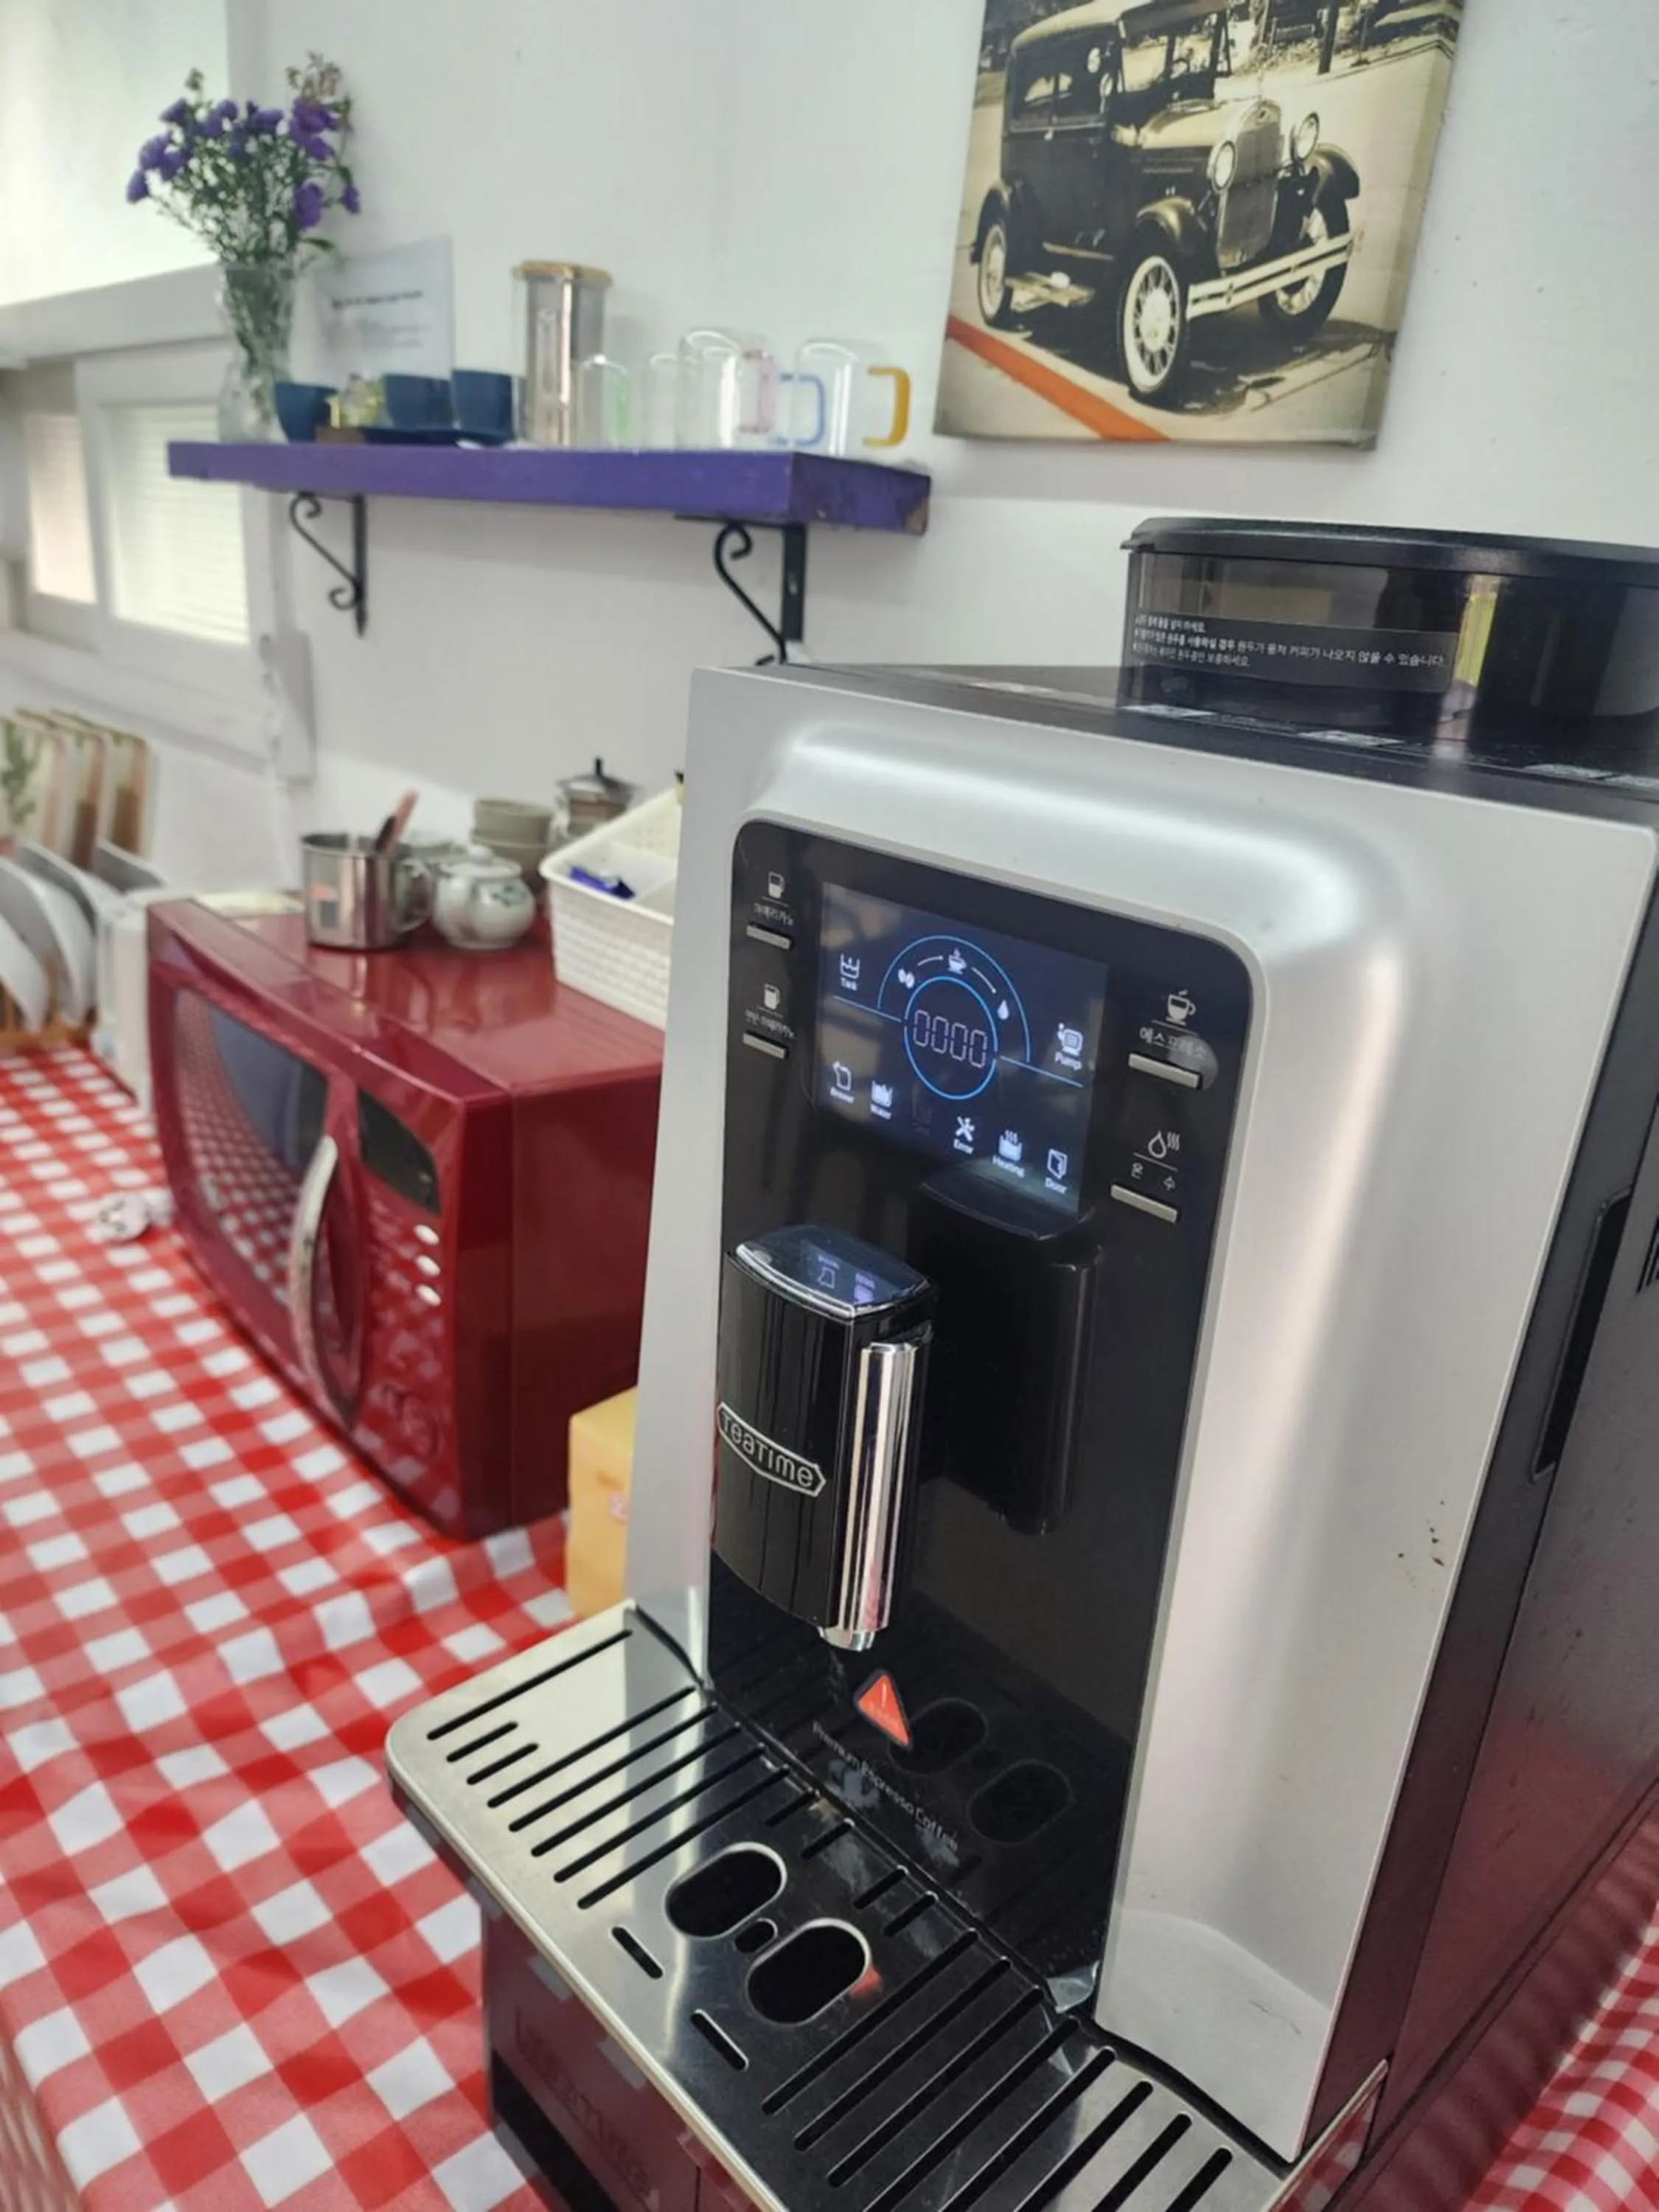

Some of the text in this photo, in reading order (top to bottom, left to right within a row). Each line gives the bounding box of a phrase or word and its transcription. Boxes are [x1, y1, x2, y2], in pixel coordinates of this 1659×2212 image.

[1290, 644, 1321, 658] 커피가
[1323, 647, 1356, 661] 나오지
[1357, 650, 1381, 664] 않을
[1383, 653, 1396, 664] 수
[913, 1009, 988, 1068] 0000
[1139, 1026, 1207, 1059] 에스프레소
[1054, 1051, 1082, 1071] Pump
[953, 1138, 975, 1155] Error
[992, 1154, 1026, 1179] Heating
[1044, 1177, 1068, 1194] Door
